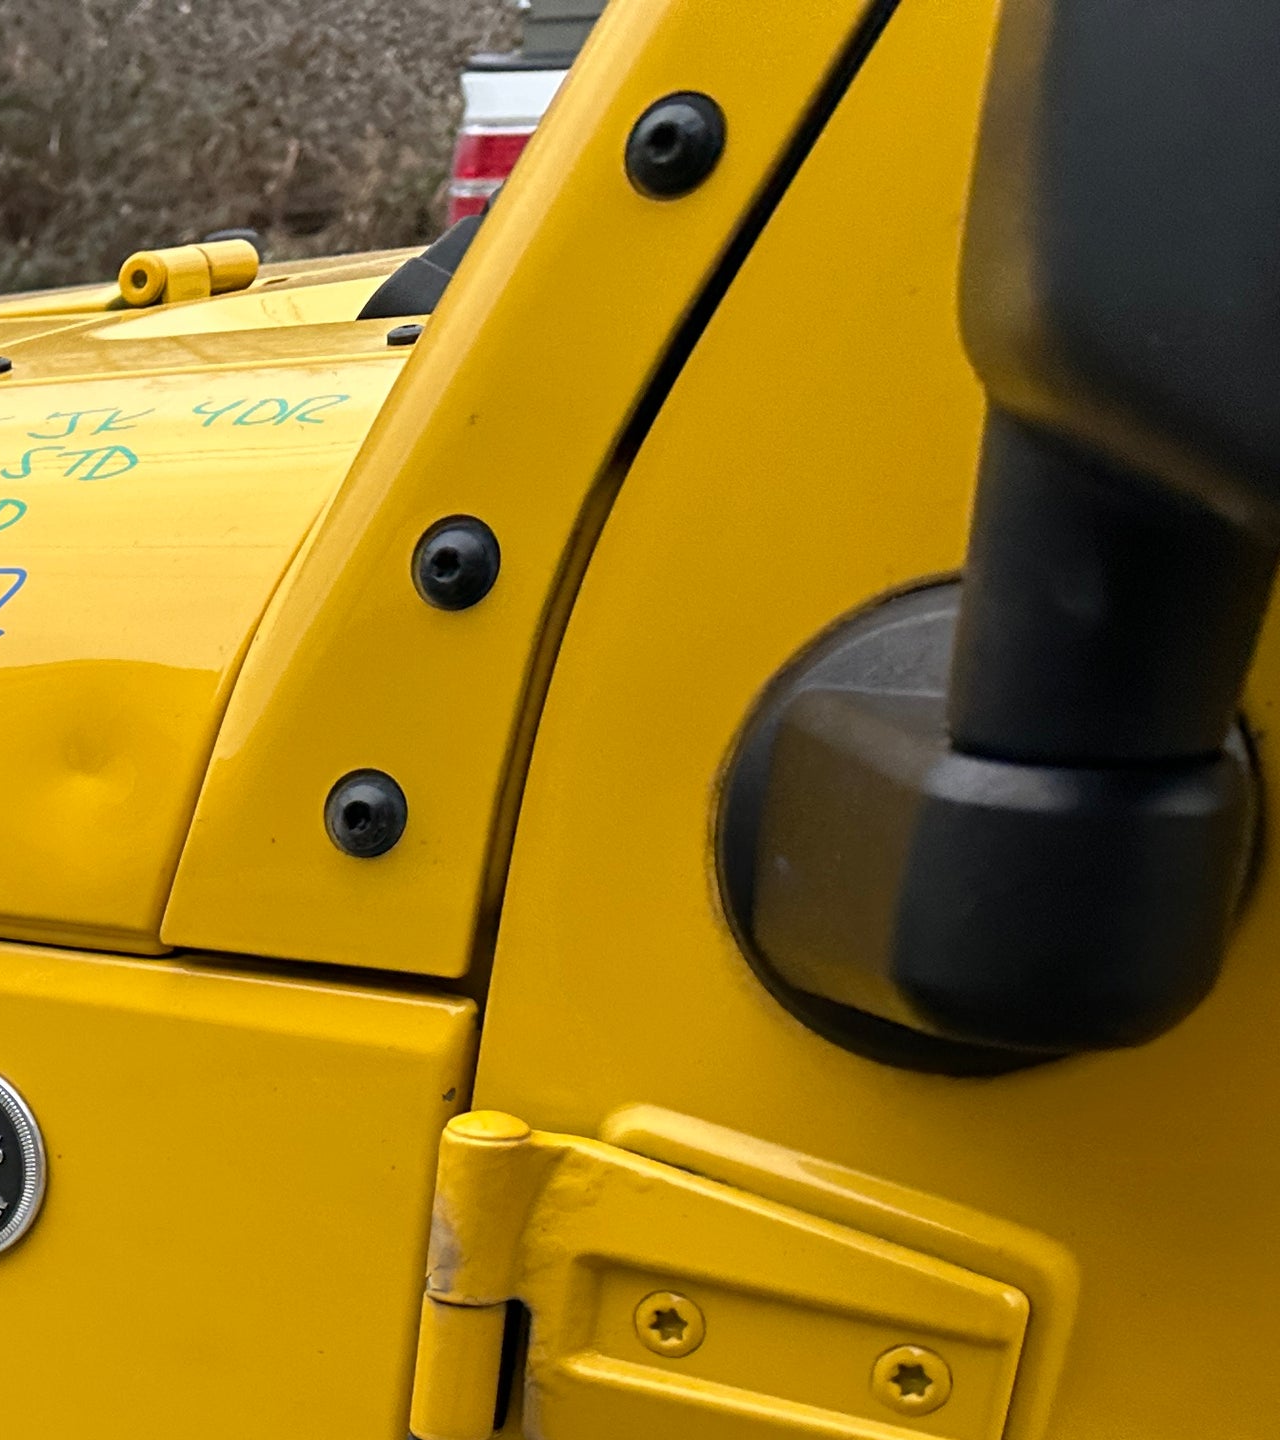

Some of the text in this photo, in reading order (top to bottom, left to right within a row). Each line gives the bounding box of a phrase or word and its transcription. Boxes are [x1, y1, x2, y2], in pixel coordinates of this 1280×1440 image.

[27, 407, 155, 439] JK
[192, 394, 351, 427] 4DR
[0, 445, 139, 481] STD
